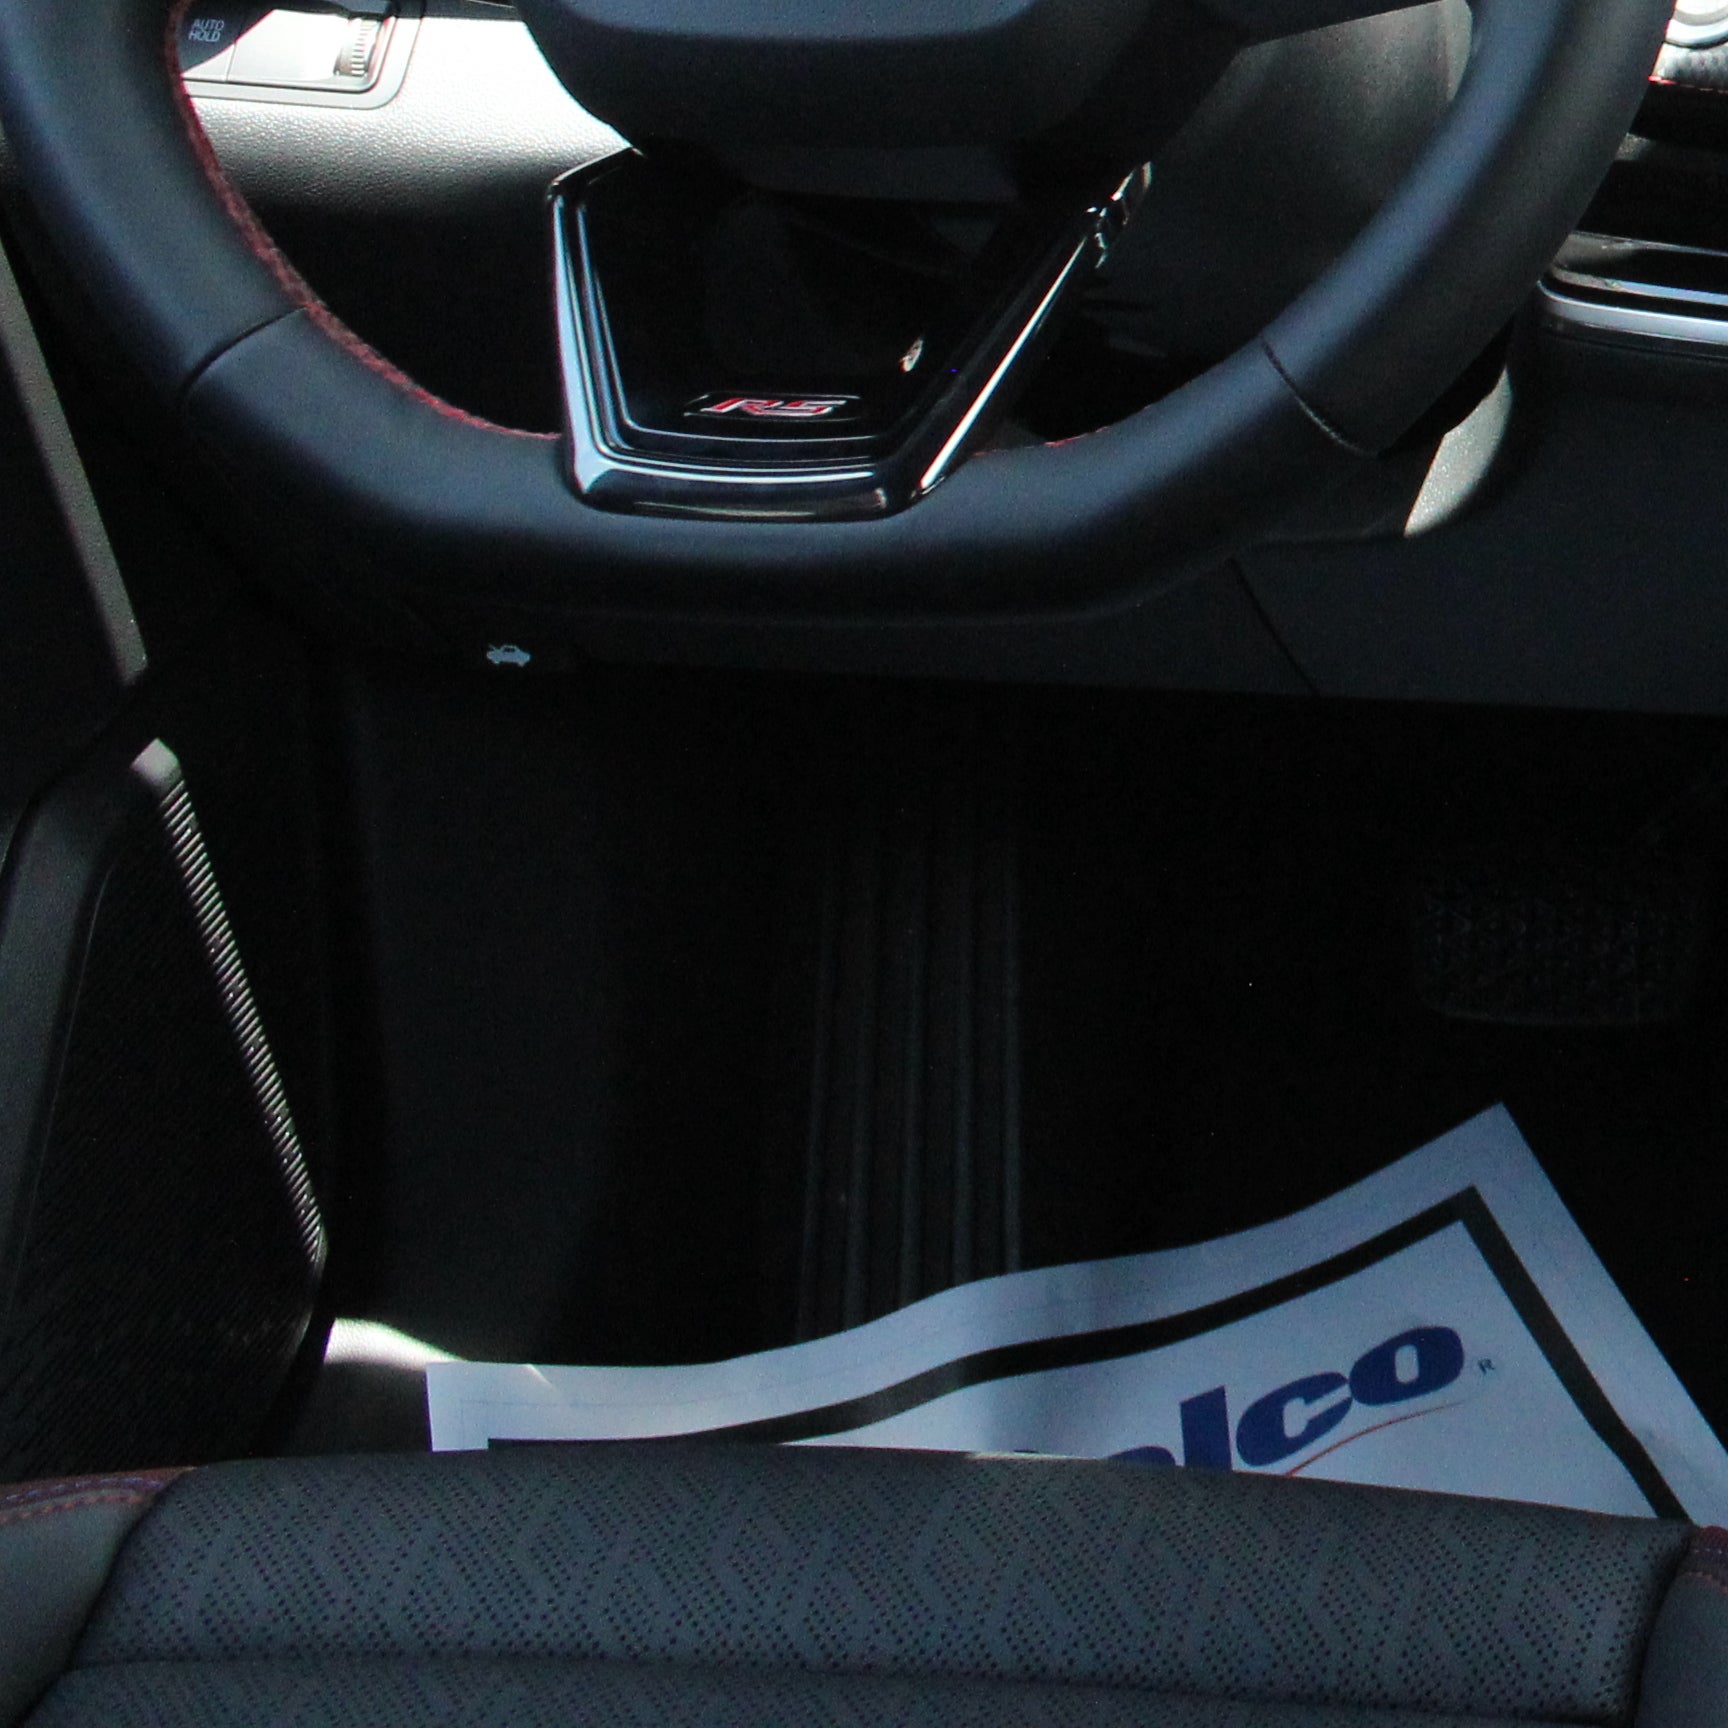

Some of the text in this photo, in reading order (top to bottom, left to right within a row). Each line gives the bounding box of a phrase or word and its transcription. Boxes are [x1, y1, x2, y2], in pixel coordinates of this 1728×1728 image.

[190, 19, 225, 32] AUTO
[188, 30, 222, 42] HOLD
[700, 397, 847, 417] RS
[1103, 1326, 1466, 1471] lco
